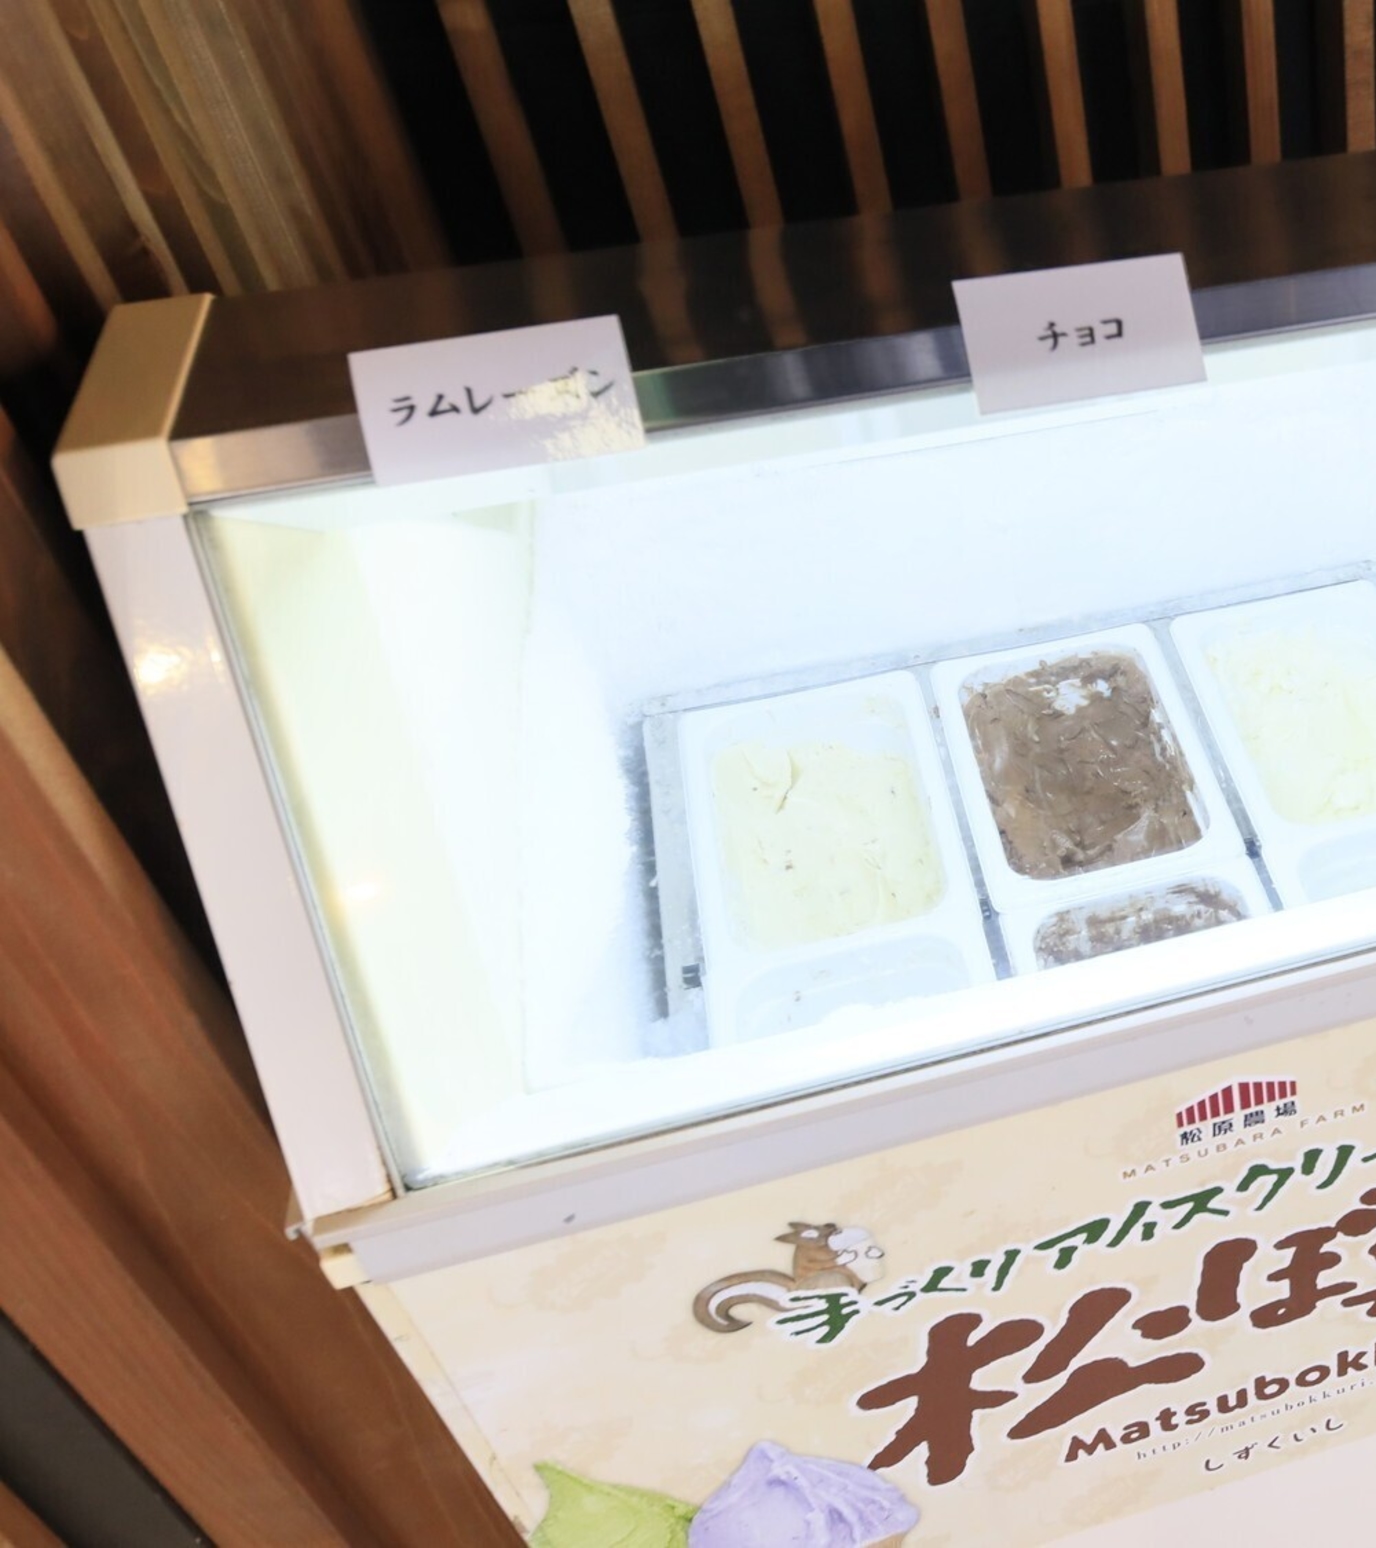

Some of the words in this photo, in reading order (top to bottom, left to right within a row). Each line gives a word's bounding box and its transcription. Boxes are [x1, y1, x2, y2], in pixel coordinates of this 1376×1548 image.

[1037, 318, 1123, 352] チョコ
[1122, 1126, 1283, 1180] MATSUBARA
[1299, 1103, 1366, 1130] FARM
[1179, 1100, 1298, 1146] 松原農場
[1204, 1416, 1345, 1472] しずくいし
